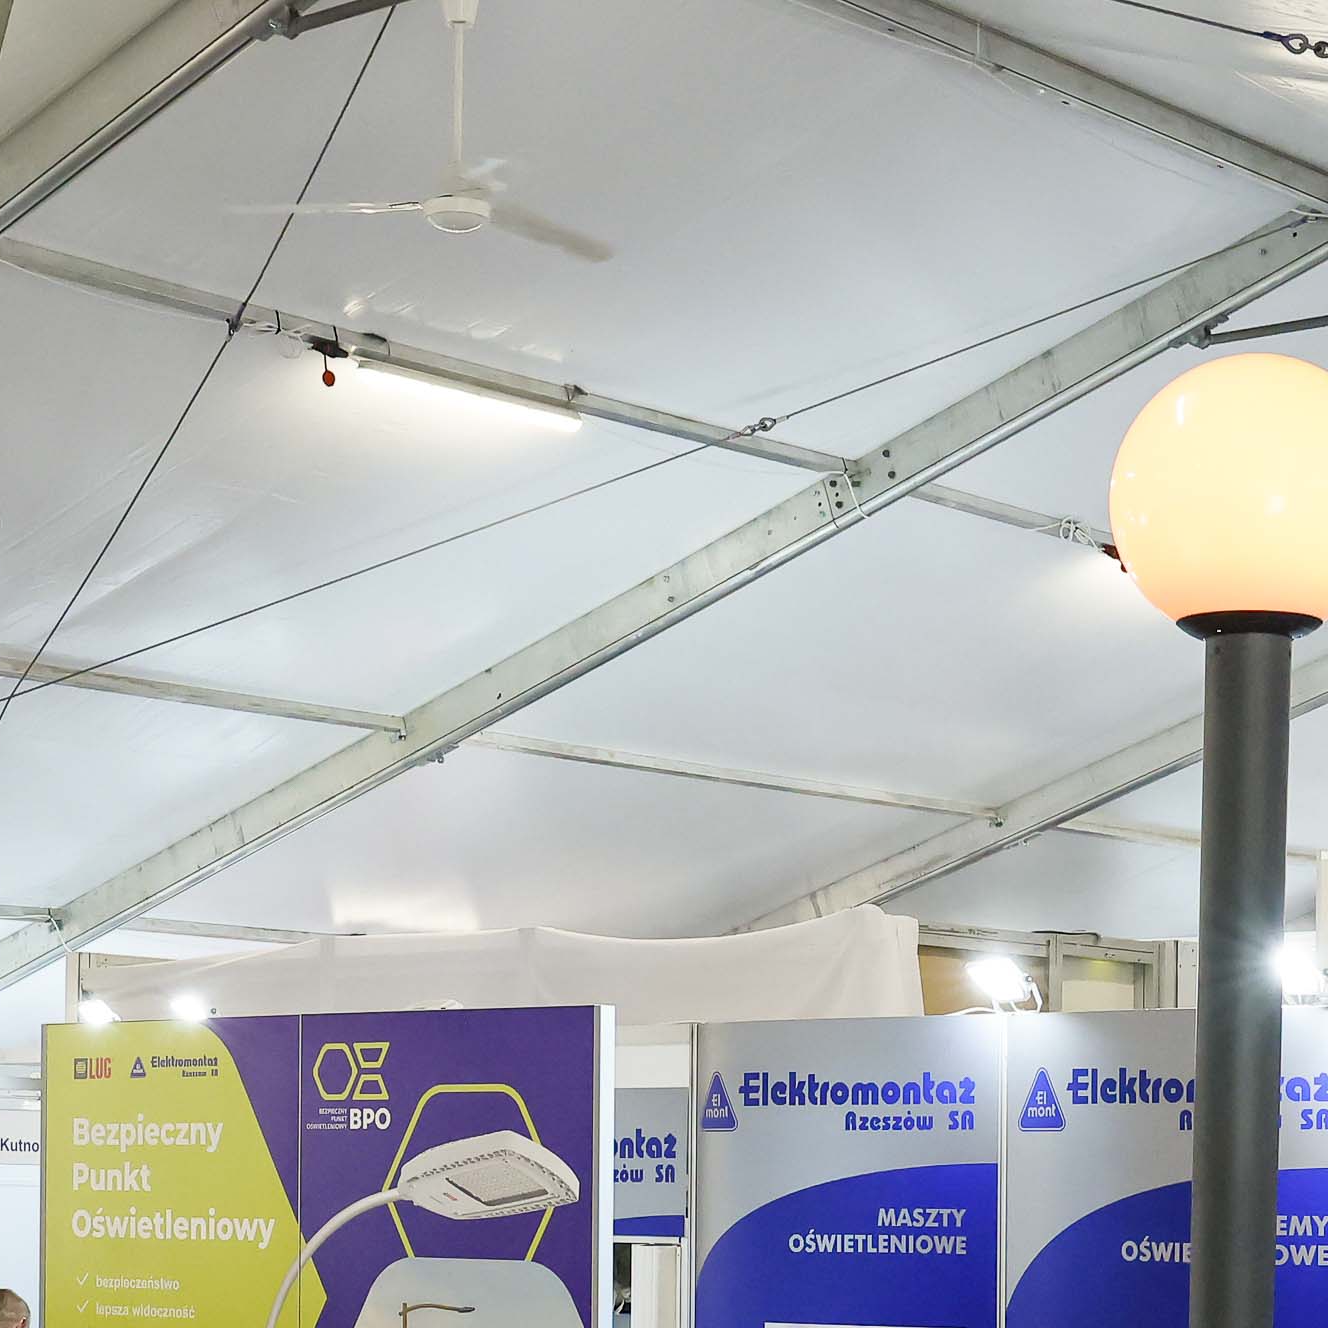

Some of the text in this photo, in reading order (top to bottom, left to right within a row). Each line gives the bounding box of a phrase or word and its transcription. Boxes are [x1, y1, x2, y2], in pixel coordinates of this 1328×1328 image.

[89, 1057, 111, 1079] LUG
[738, 1072, 976, 1106] Elektromontaż
[350, 1107, 391, 1129] BPO
[705, 1107, 729, 1118] mont
[845, 1110, 974, 1131] Rzeszów SA
[1028, 1104, 1056, 1117] mont
[73, 1113, 223, 1153] Bezpieczny
[0, 1138, 39, 1152] Kutno
[73, 1161, 152, 1192] Punkt
[72, 1206, 275, 1249] Oświetleniowy
[877, 1208, 966, 1228] MASZTY
[788, 1229, 967, 1255] OŚWIETLENIOWE
[96, 1274, 180, 1291] bezpieczeństwo
[132, 1304, 195, 1319] widoczność
